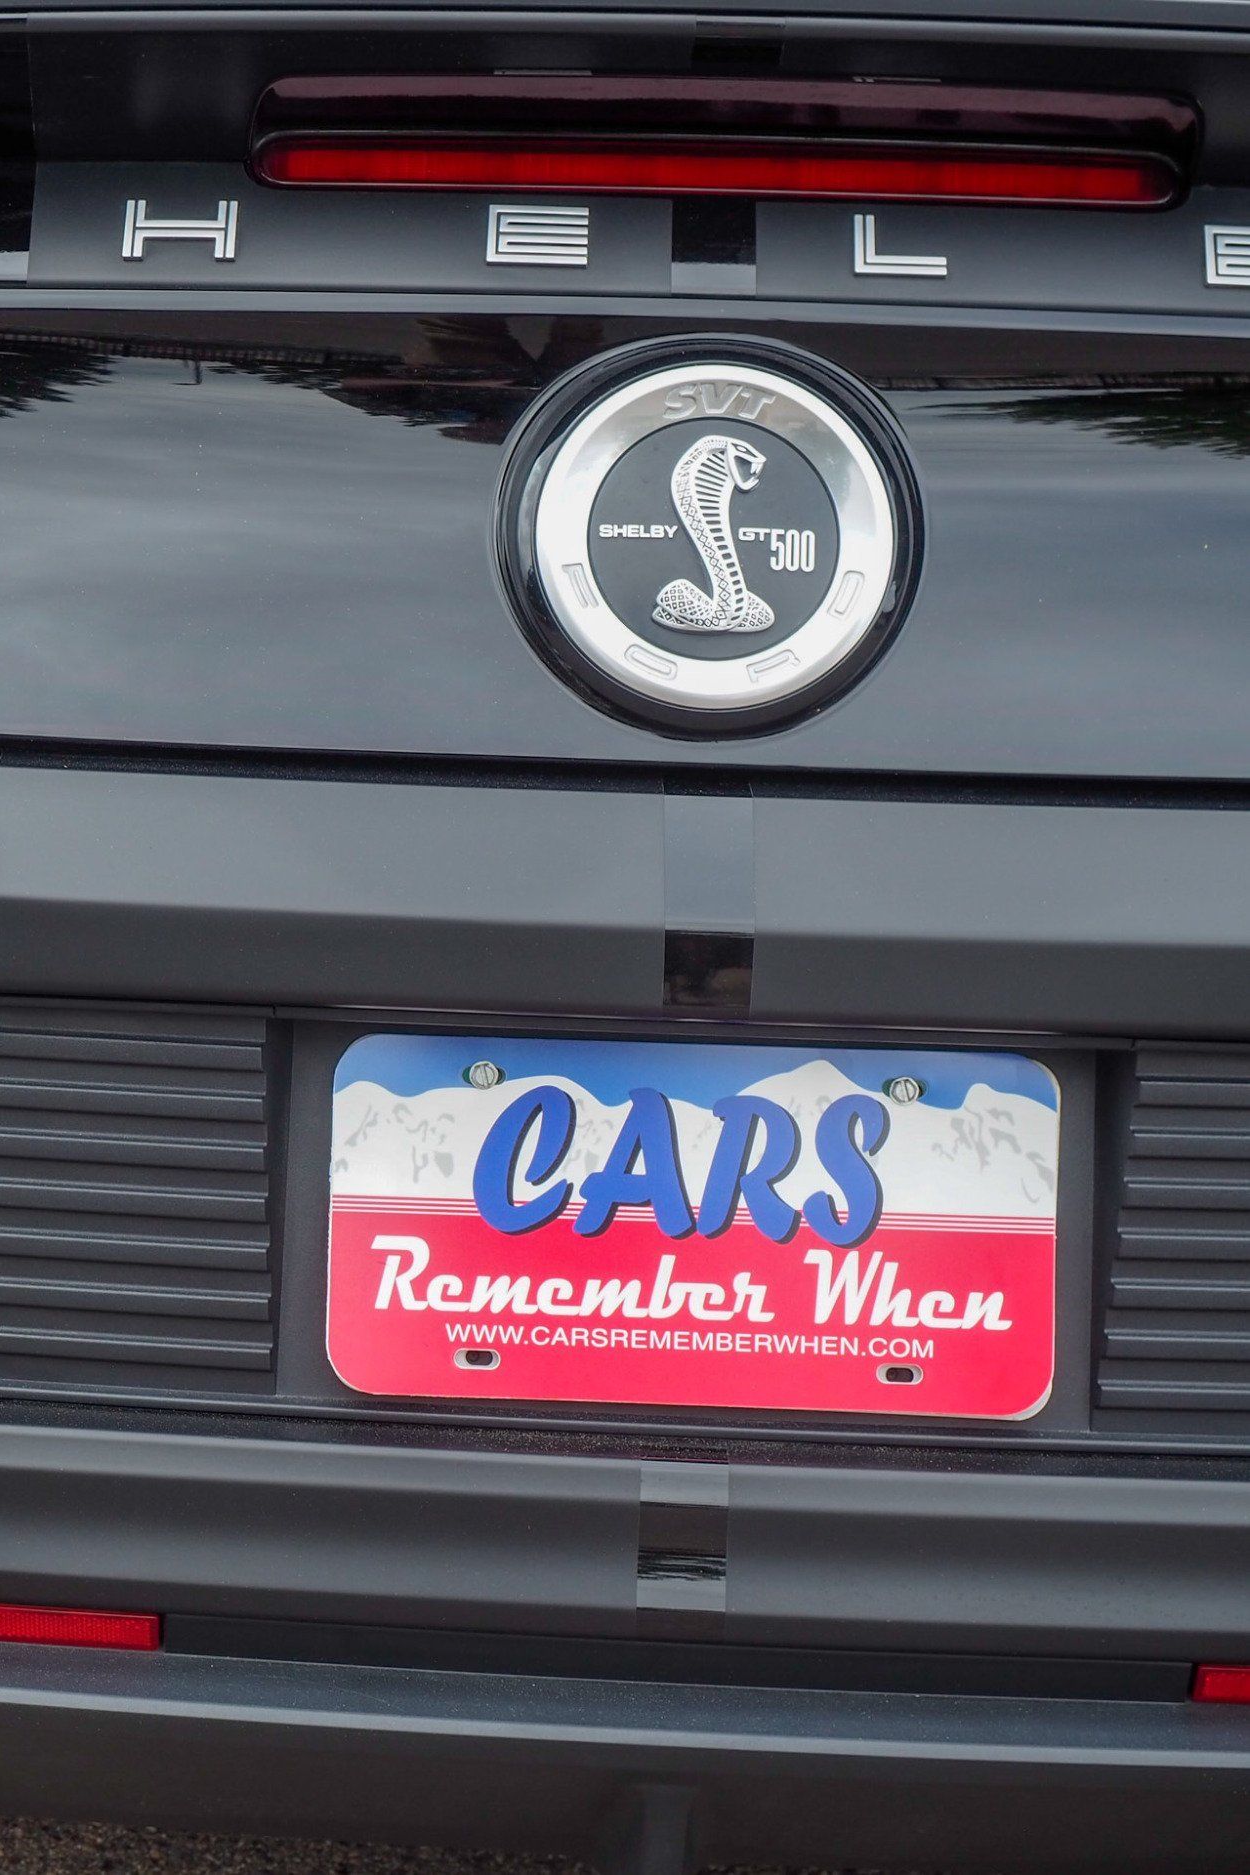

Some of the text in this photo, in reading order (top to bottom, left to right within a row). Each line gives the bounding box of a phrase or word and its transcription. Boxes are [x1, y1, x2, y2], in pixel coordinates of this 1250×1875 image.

[662, 382, 776, 420] SVT
[598, 523, 679, 539] SHELBY
[561, 562, 866, 685] FORD
[471, 1085, 891, 1249] CARS
[370, 1234, 1014, 1333] Remember When
[445, 1322, 935, 1360] WWW.CARSREMEMBERWHEN.COM
